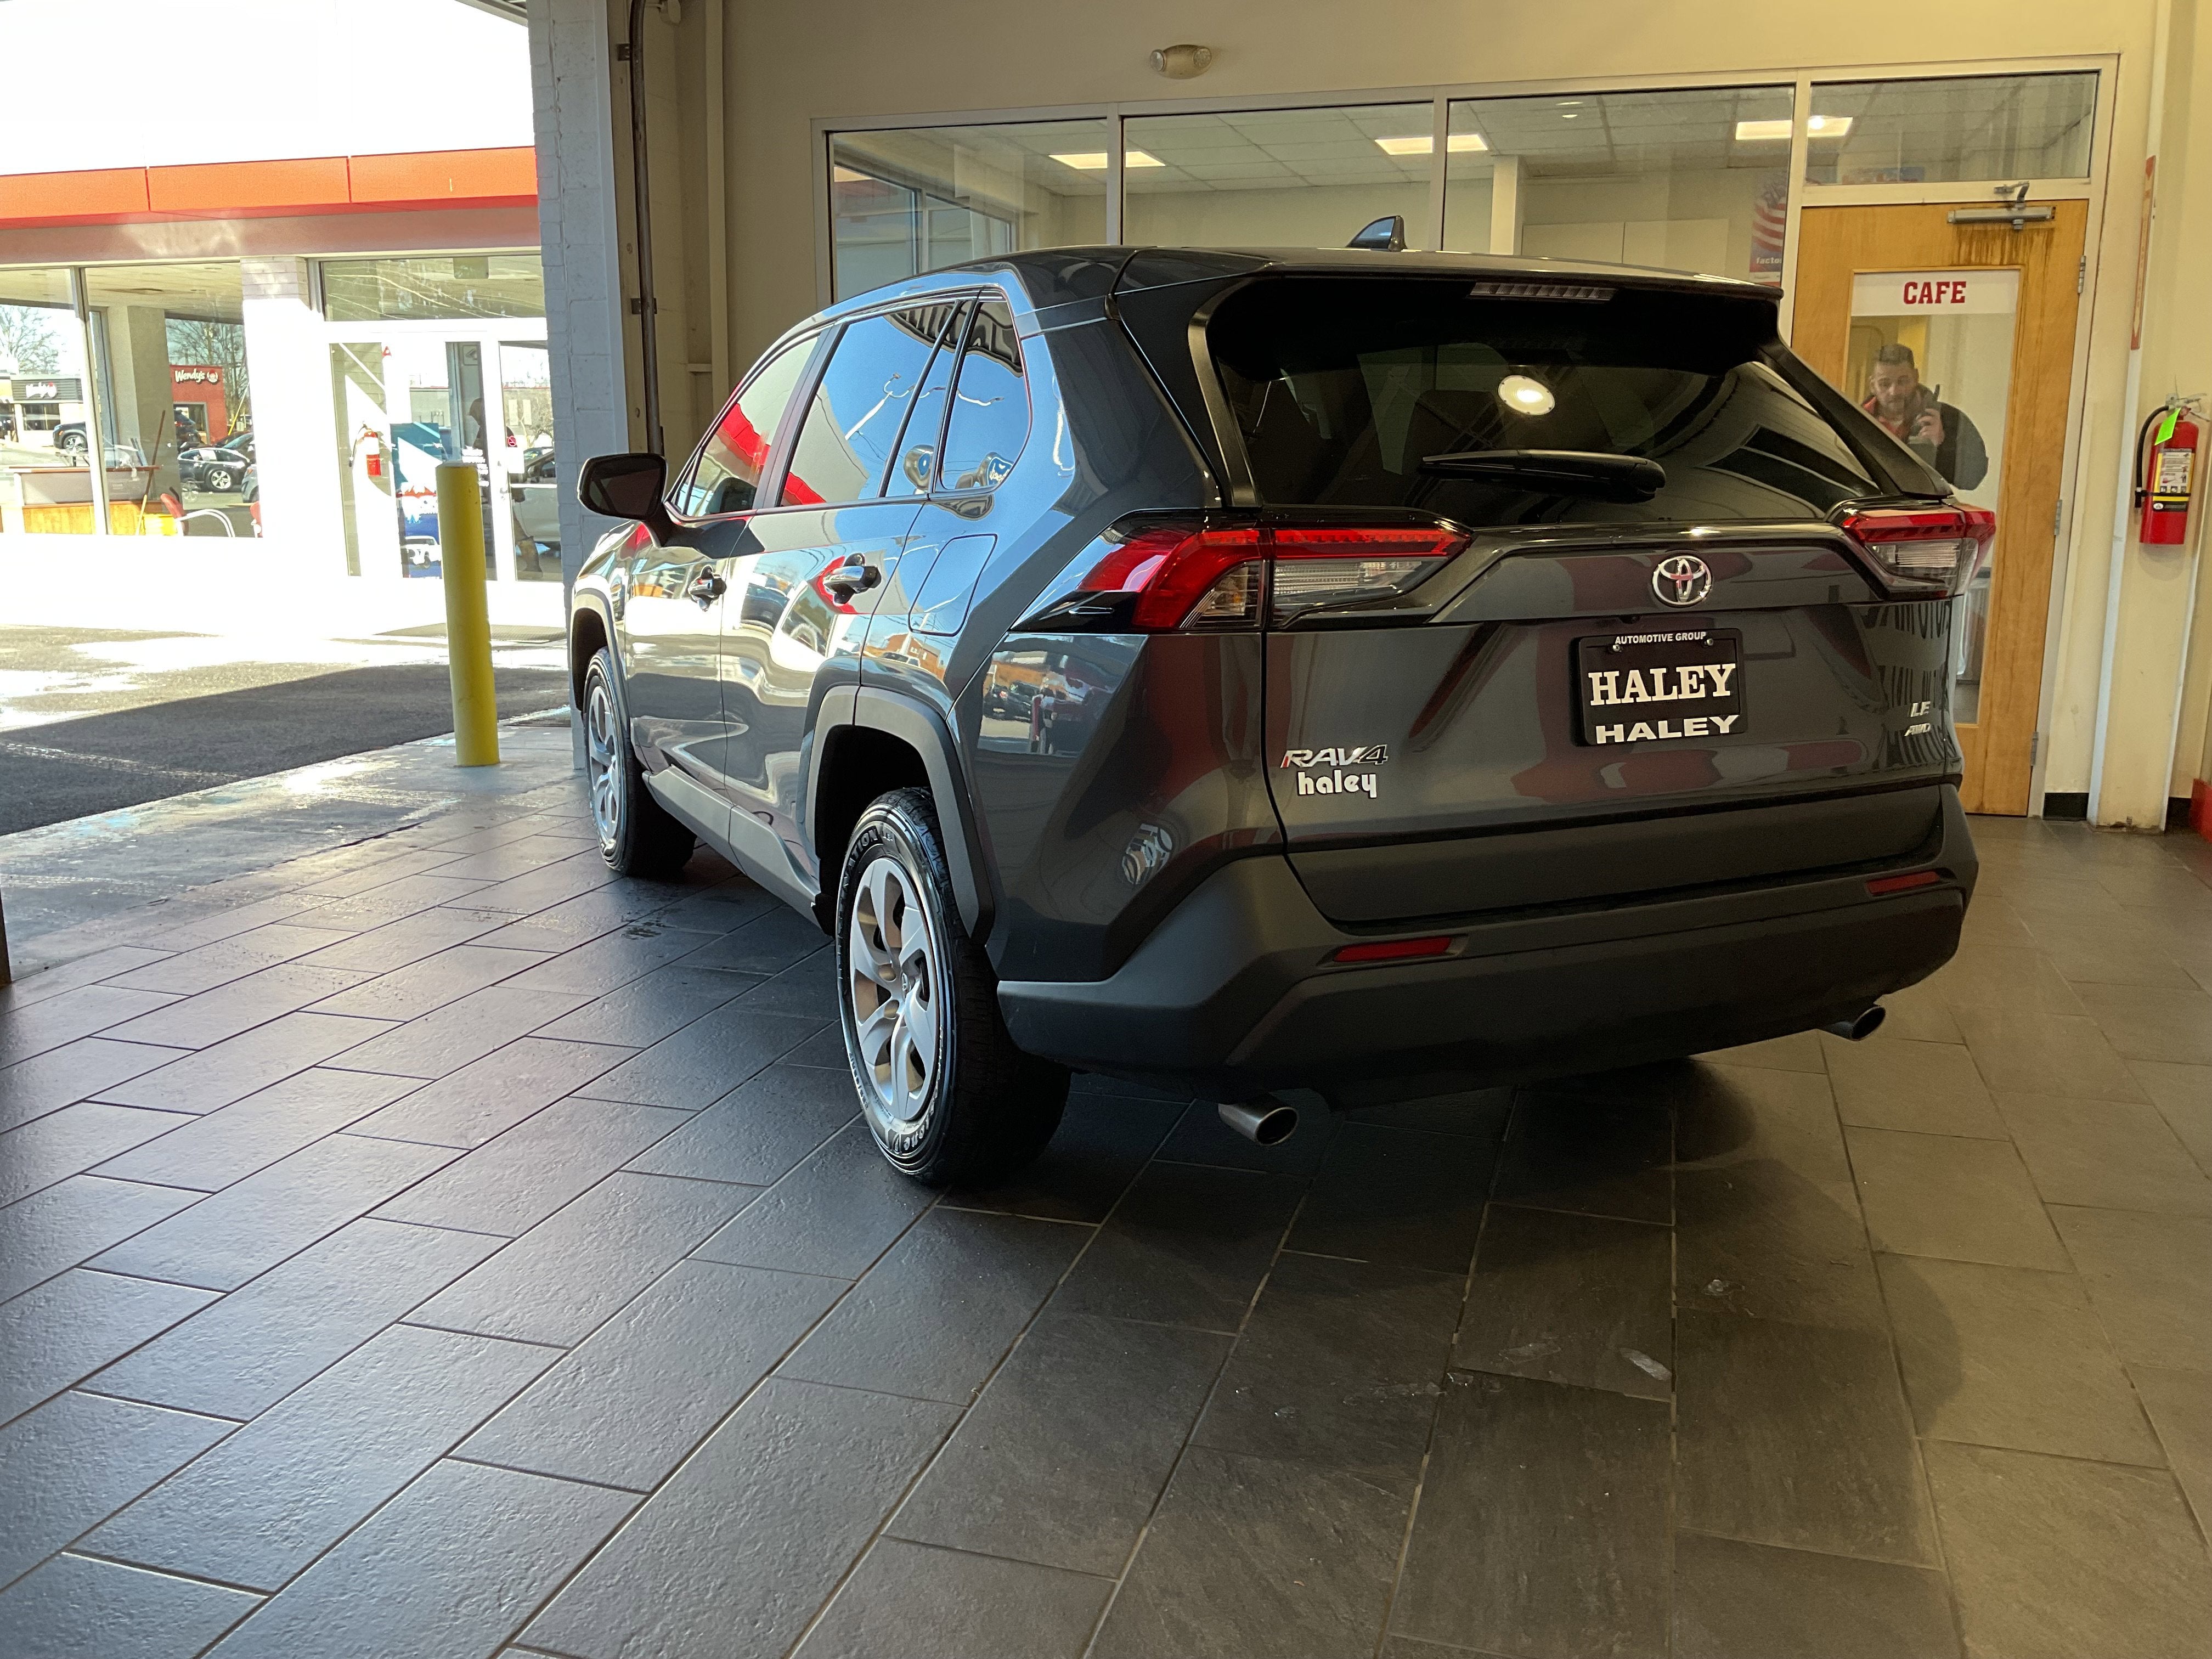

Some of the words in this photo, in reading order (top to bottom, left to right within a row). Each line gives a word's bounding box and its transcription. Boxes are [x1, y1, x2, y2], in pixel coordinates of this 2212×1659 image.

[1904, 281, 1966, 304] CAFE
[174, 368, 205, 382] Wendy's
[1615, 633, 1673, 645] AUTOMOTIVE
[1675, 631, 1706, 641] GROUP
[1588, 663, 1736, 706] HALEY
[1910, 701, 1931, 717] LE
[1595, 714, 1739, 744] HALEY
[1280, 744, 1389, 768] RAV4
[1297, 769, 1377, 798] haley
